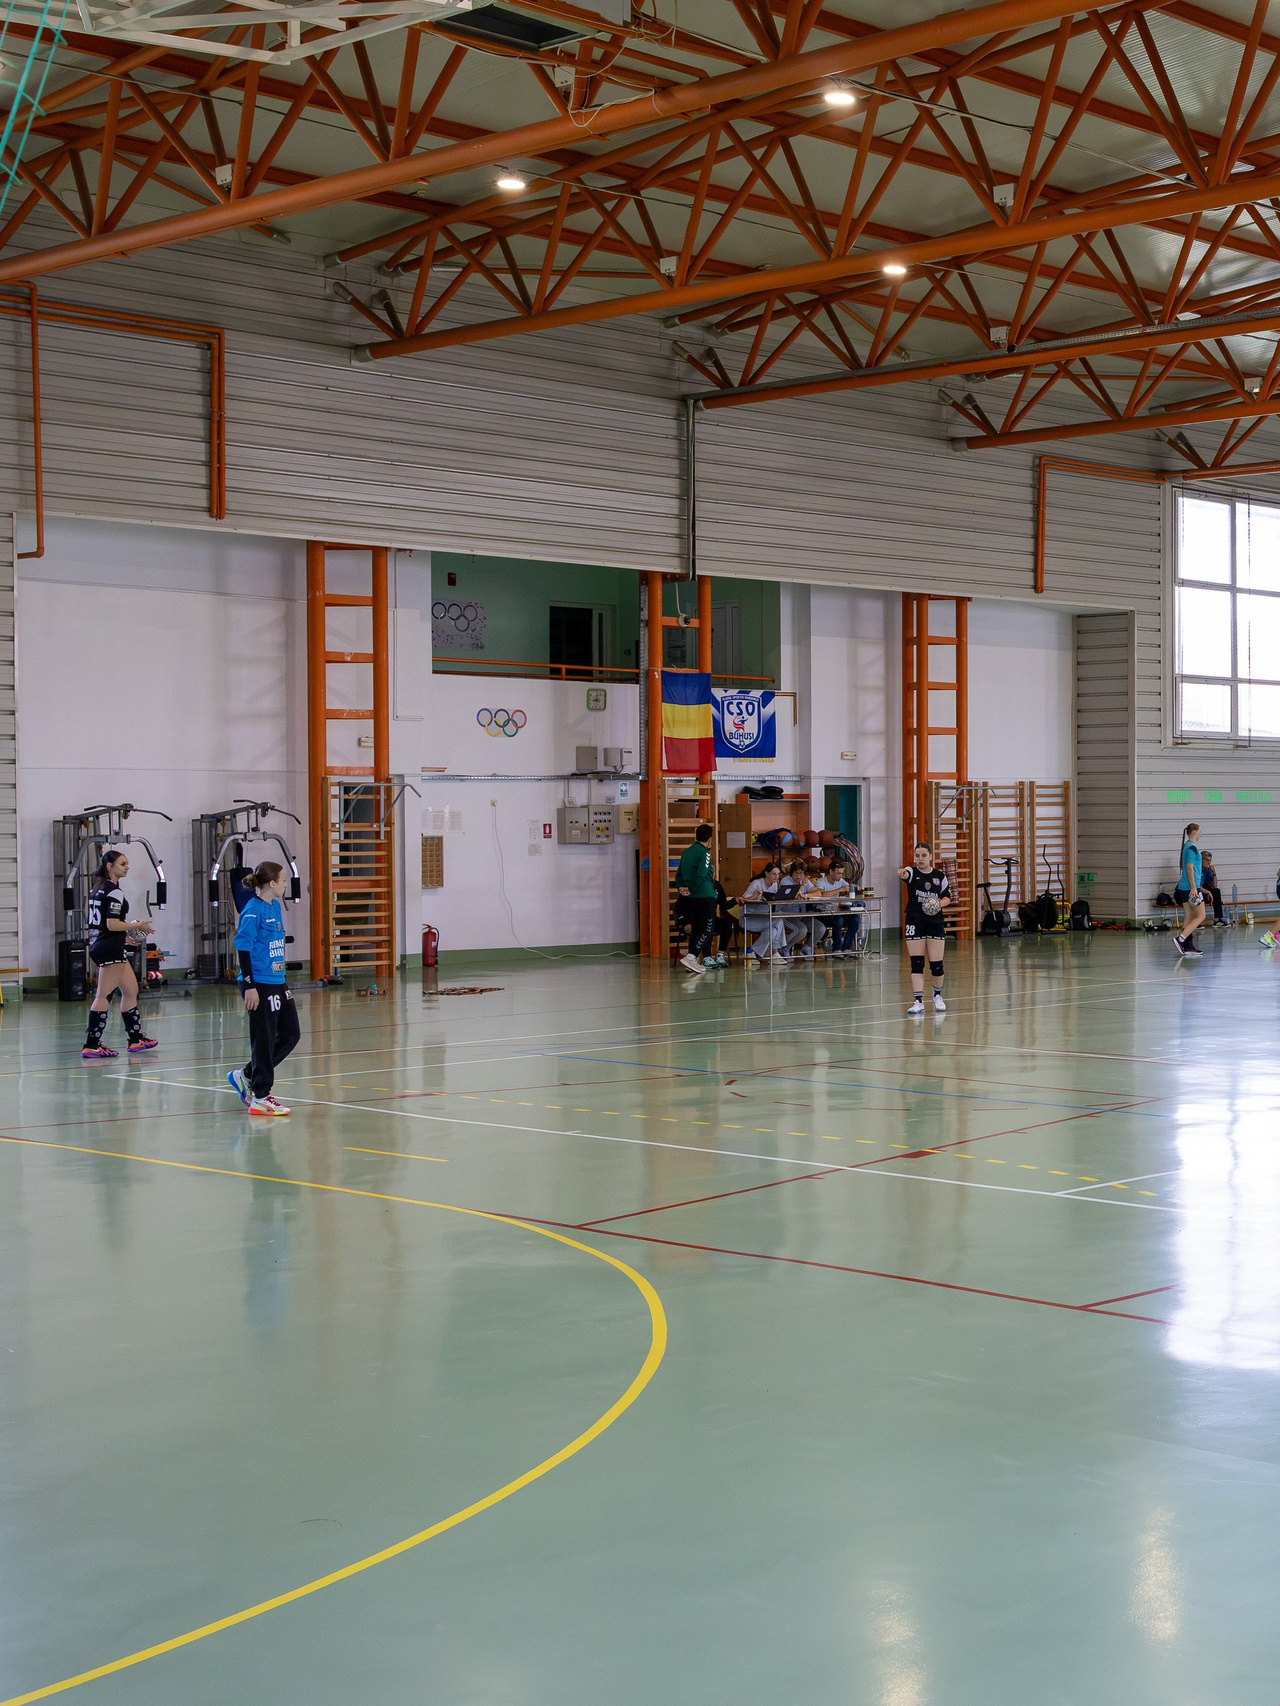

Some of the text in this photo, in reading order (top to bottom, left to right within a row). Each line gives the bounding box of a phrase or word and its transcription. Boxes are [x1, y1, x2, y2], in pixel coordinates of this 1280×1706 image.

[726, 701, 756, 717] CSO
[905, 924, 916, 936] 28
[268, 994, 281, 1012] 16
